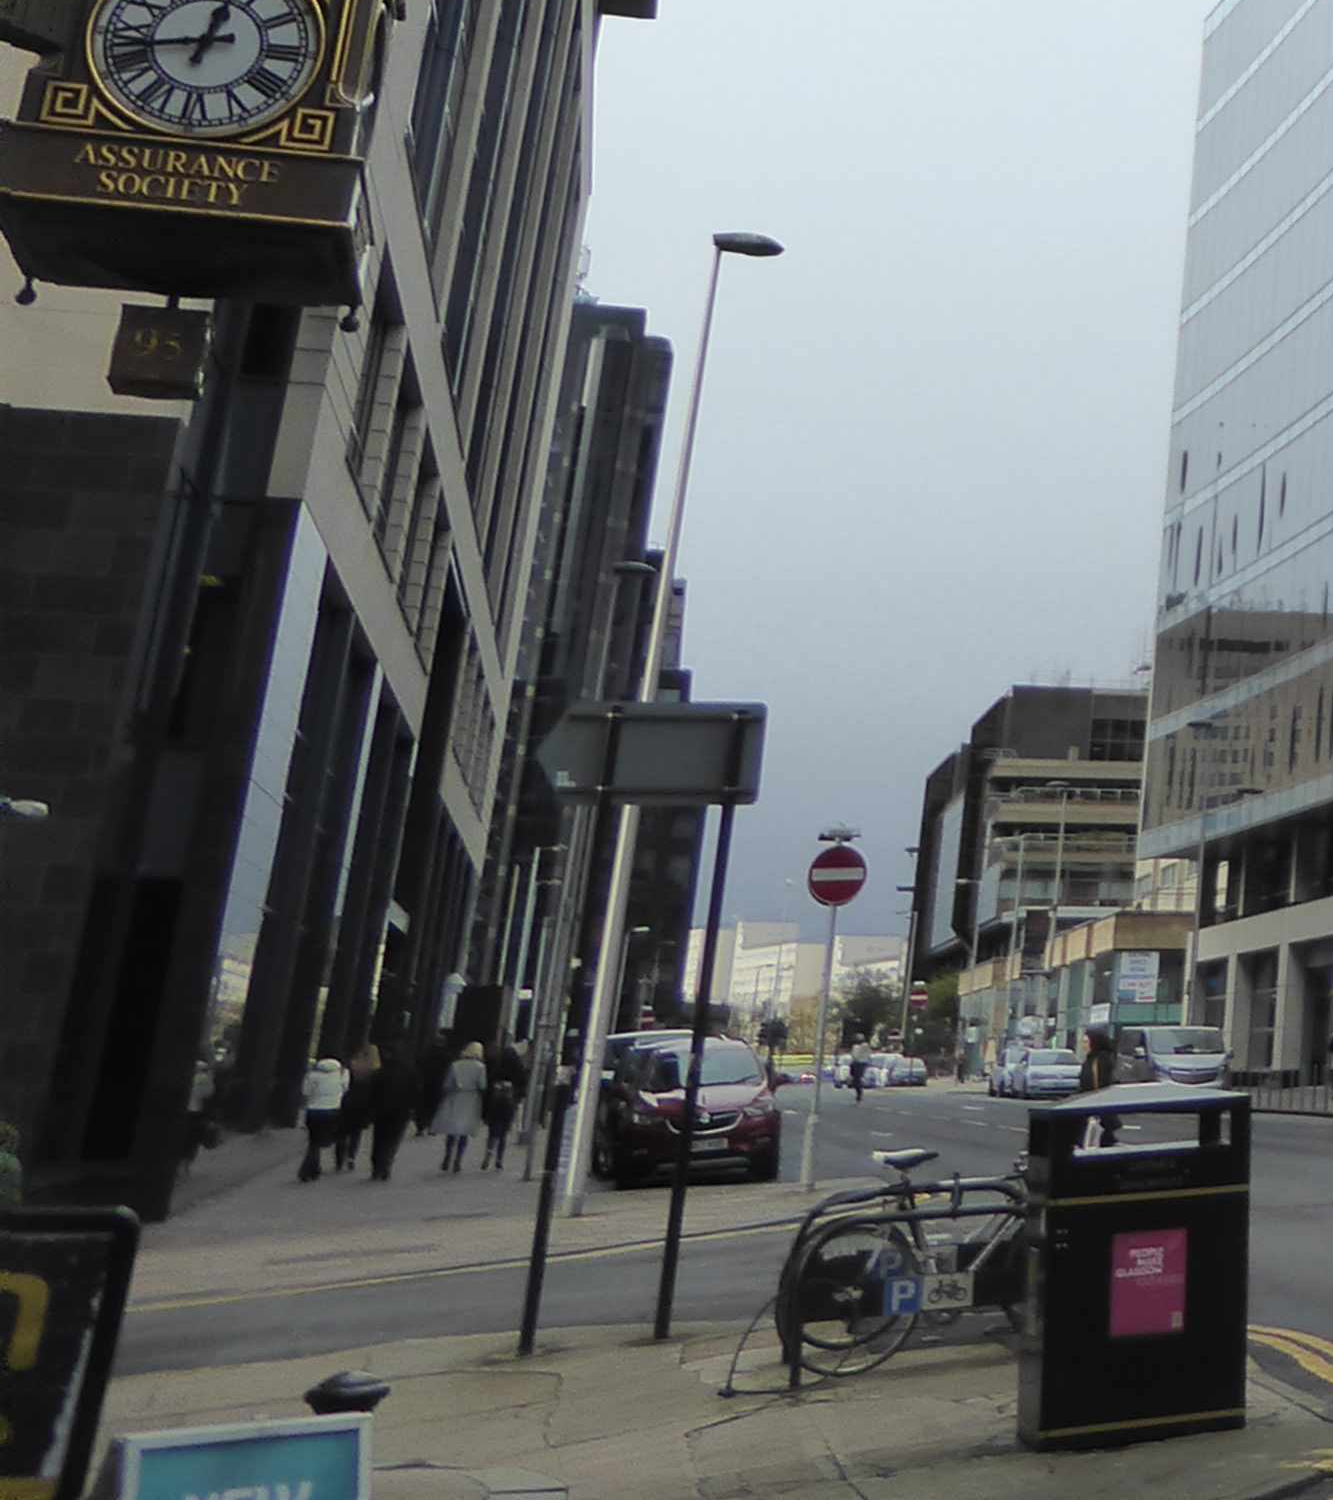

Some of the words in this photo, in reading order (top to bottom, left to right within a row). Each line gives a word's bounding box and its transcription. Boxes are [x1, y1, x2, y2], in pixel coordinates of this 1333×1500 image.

[74, 142, 283, 184] ASSURANCE
[96, 170, 249, 206] SOCIETY
[1115, 1265, 1163, 1277] GLASGOW
[891, 1281, 915, 1312] P
